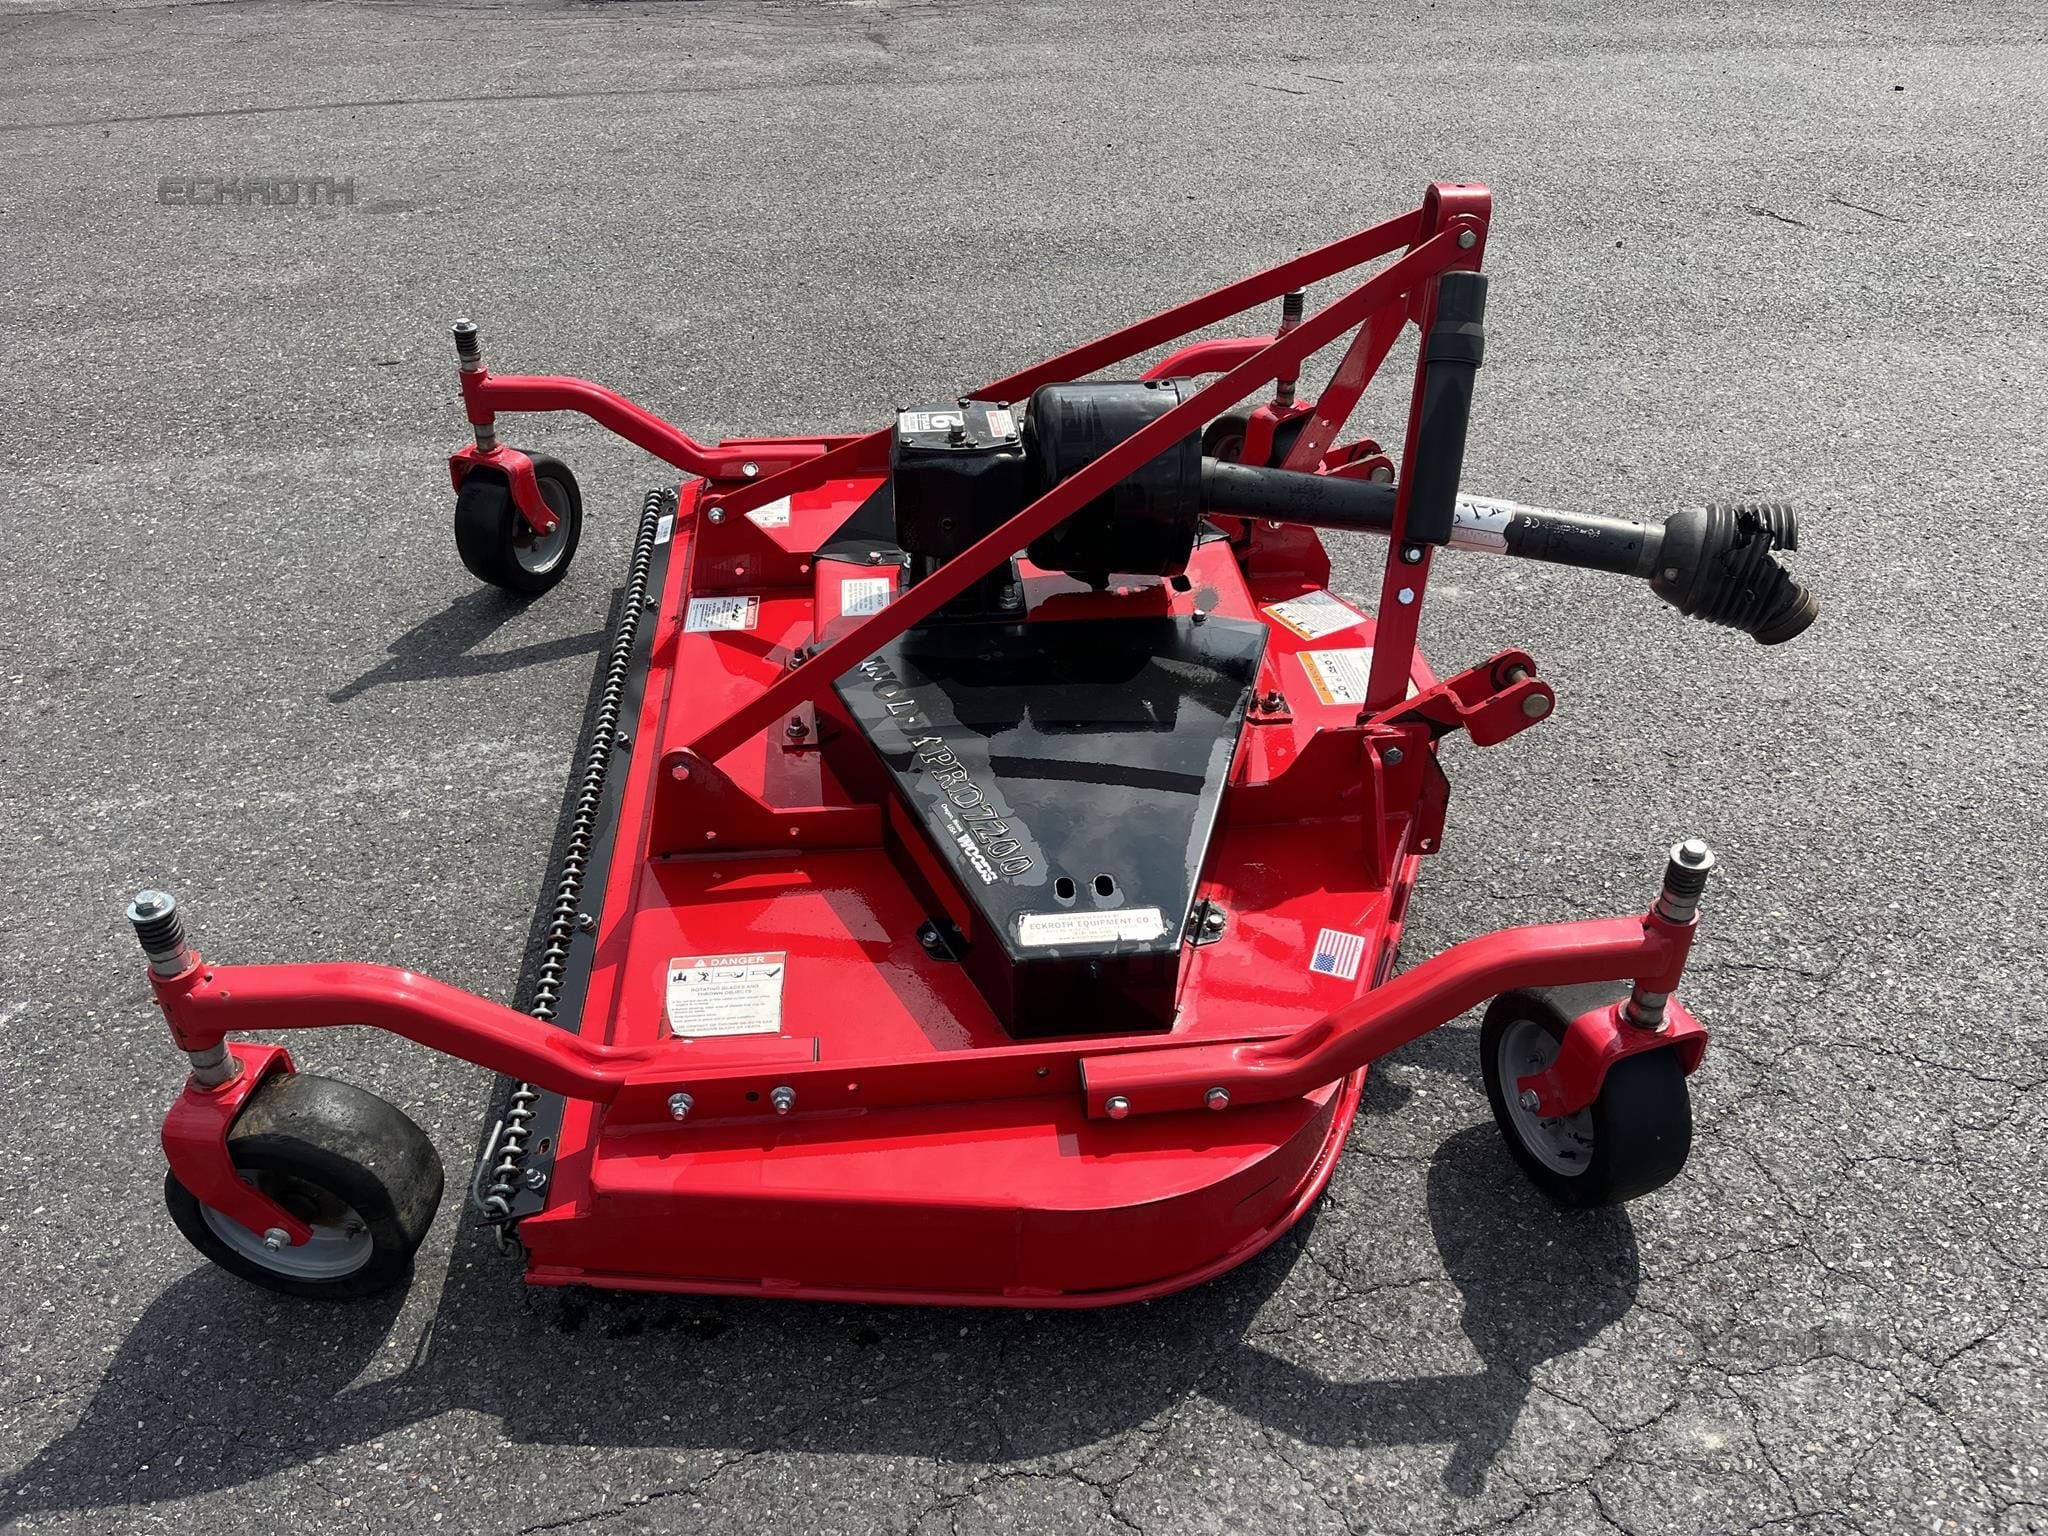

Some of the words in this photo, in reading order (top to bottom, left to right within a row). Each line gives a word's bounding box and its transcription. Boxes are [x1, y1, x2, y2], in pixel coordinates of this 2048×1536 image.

[946, 823, 958, 836] USA
[1030, 921, 1073, 930] ECKROTH
[1077, 917, 1132, 928] EQUIPMENT
[711, 956, 765, 966] DANGER
